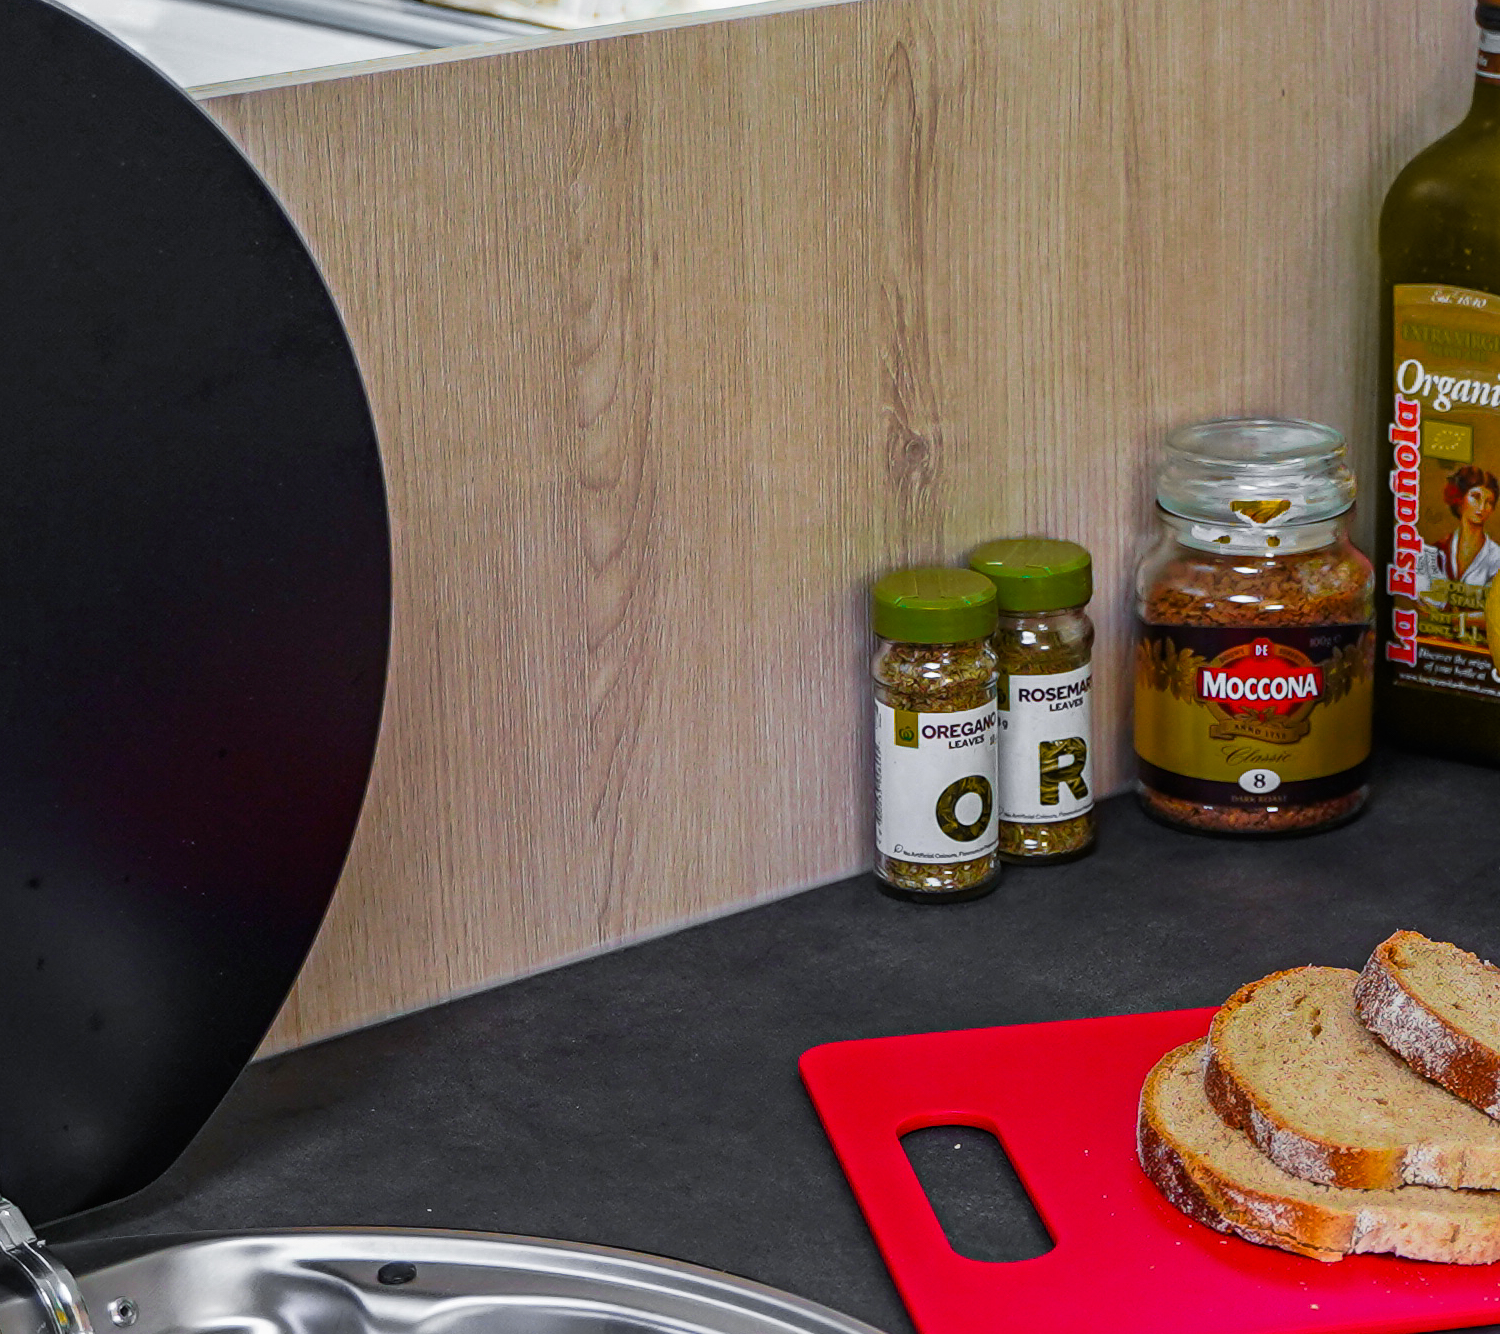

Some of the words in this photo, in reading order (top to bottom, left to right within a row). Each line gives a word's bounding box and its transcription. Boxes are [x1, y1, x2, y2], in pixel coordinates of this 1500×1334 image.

[1386, 393, 1424, 601] Española
[1386, 609, 1419, 668] La
[1202, 670, 1318, 701] MOCCONA
[1049, 697, 1084, 712] LEAVES
[922, 711, 996, 740] OREGANO
[948, 734, 985, 750] LEAVES
[1221, 744, 1291, 767] Classic
[1039, 736, 1088, 806] R
[1253, 773, 1266, 789] 8
[935, 774, 993, 843] O
